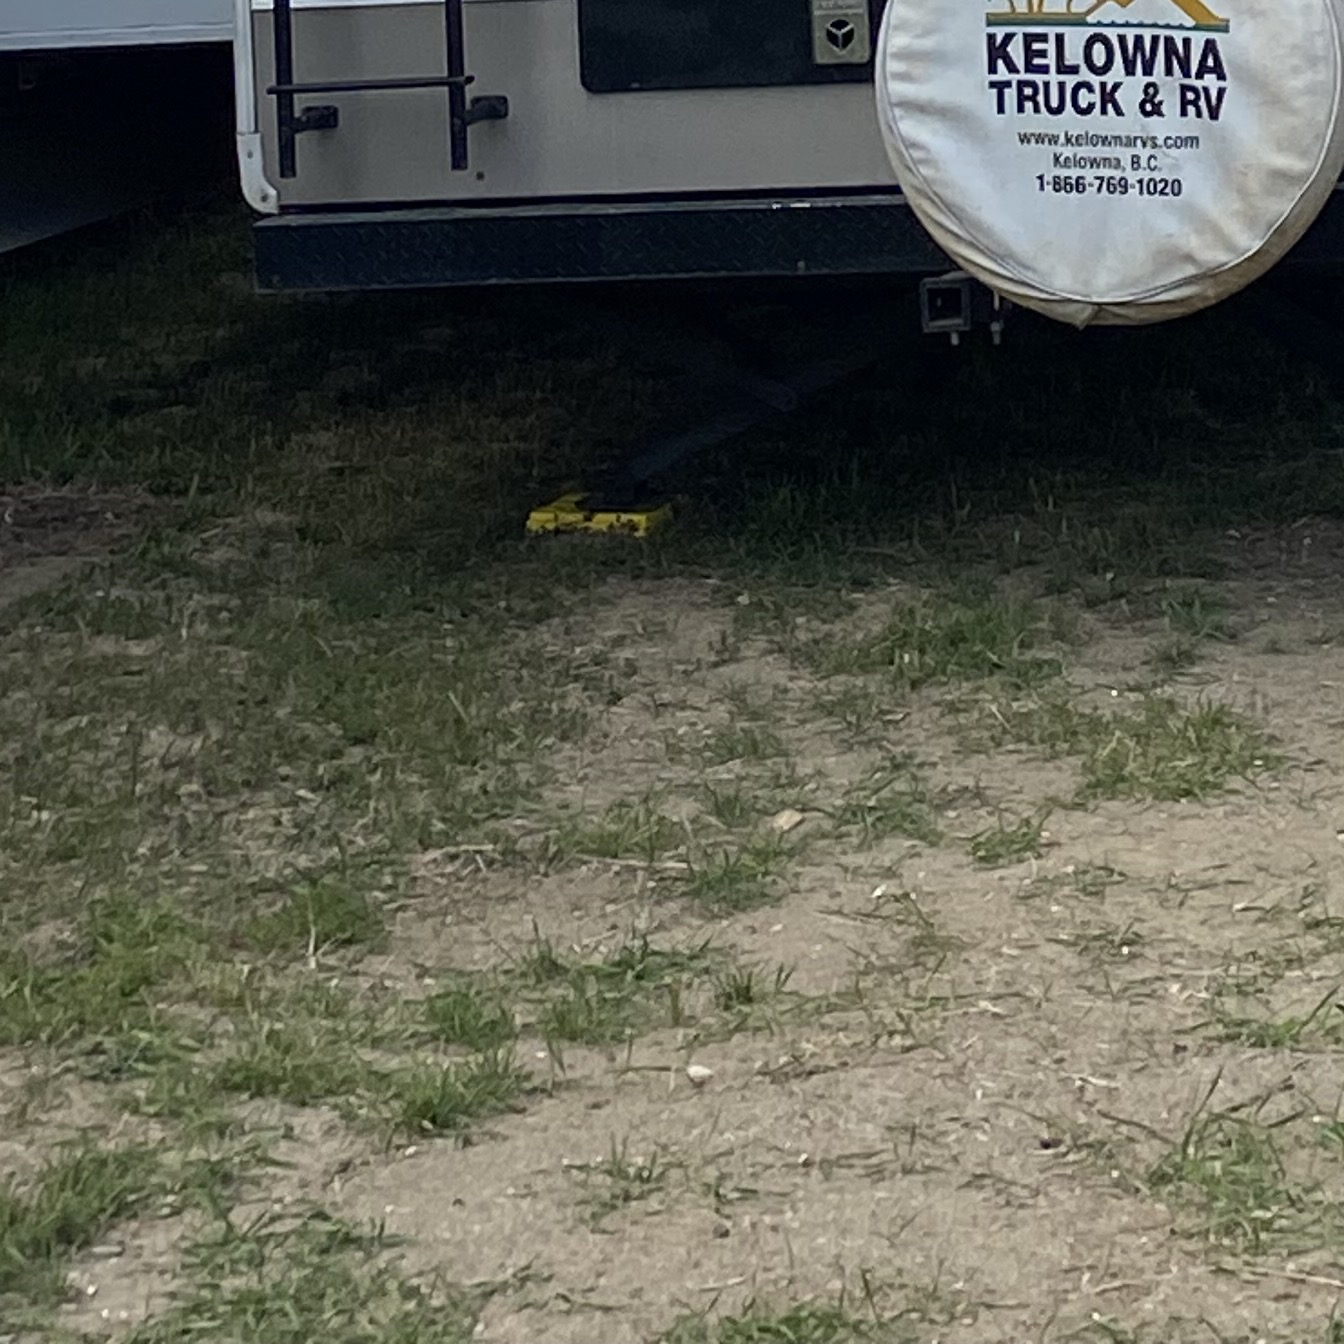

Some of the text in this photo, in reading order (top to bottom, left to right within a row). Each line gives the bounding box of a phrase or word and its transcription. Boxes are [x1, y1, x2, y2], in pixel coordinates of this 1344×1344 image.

[986, 32, 1227, 82] KELOWNA
[988, 80, 1227, 121] TRUCK & RV
[1017, 130, 1200, 150] www.kelownarvs.com
[1052, 152, 1163, 173] Kelowna, B.C.
[1035, 173, 1183, 197] 1-866-769-1020
